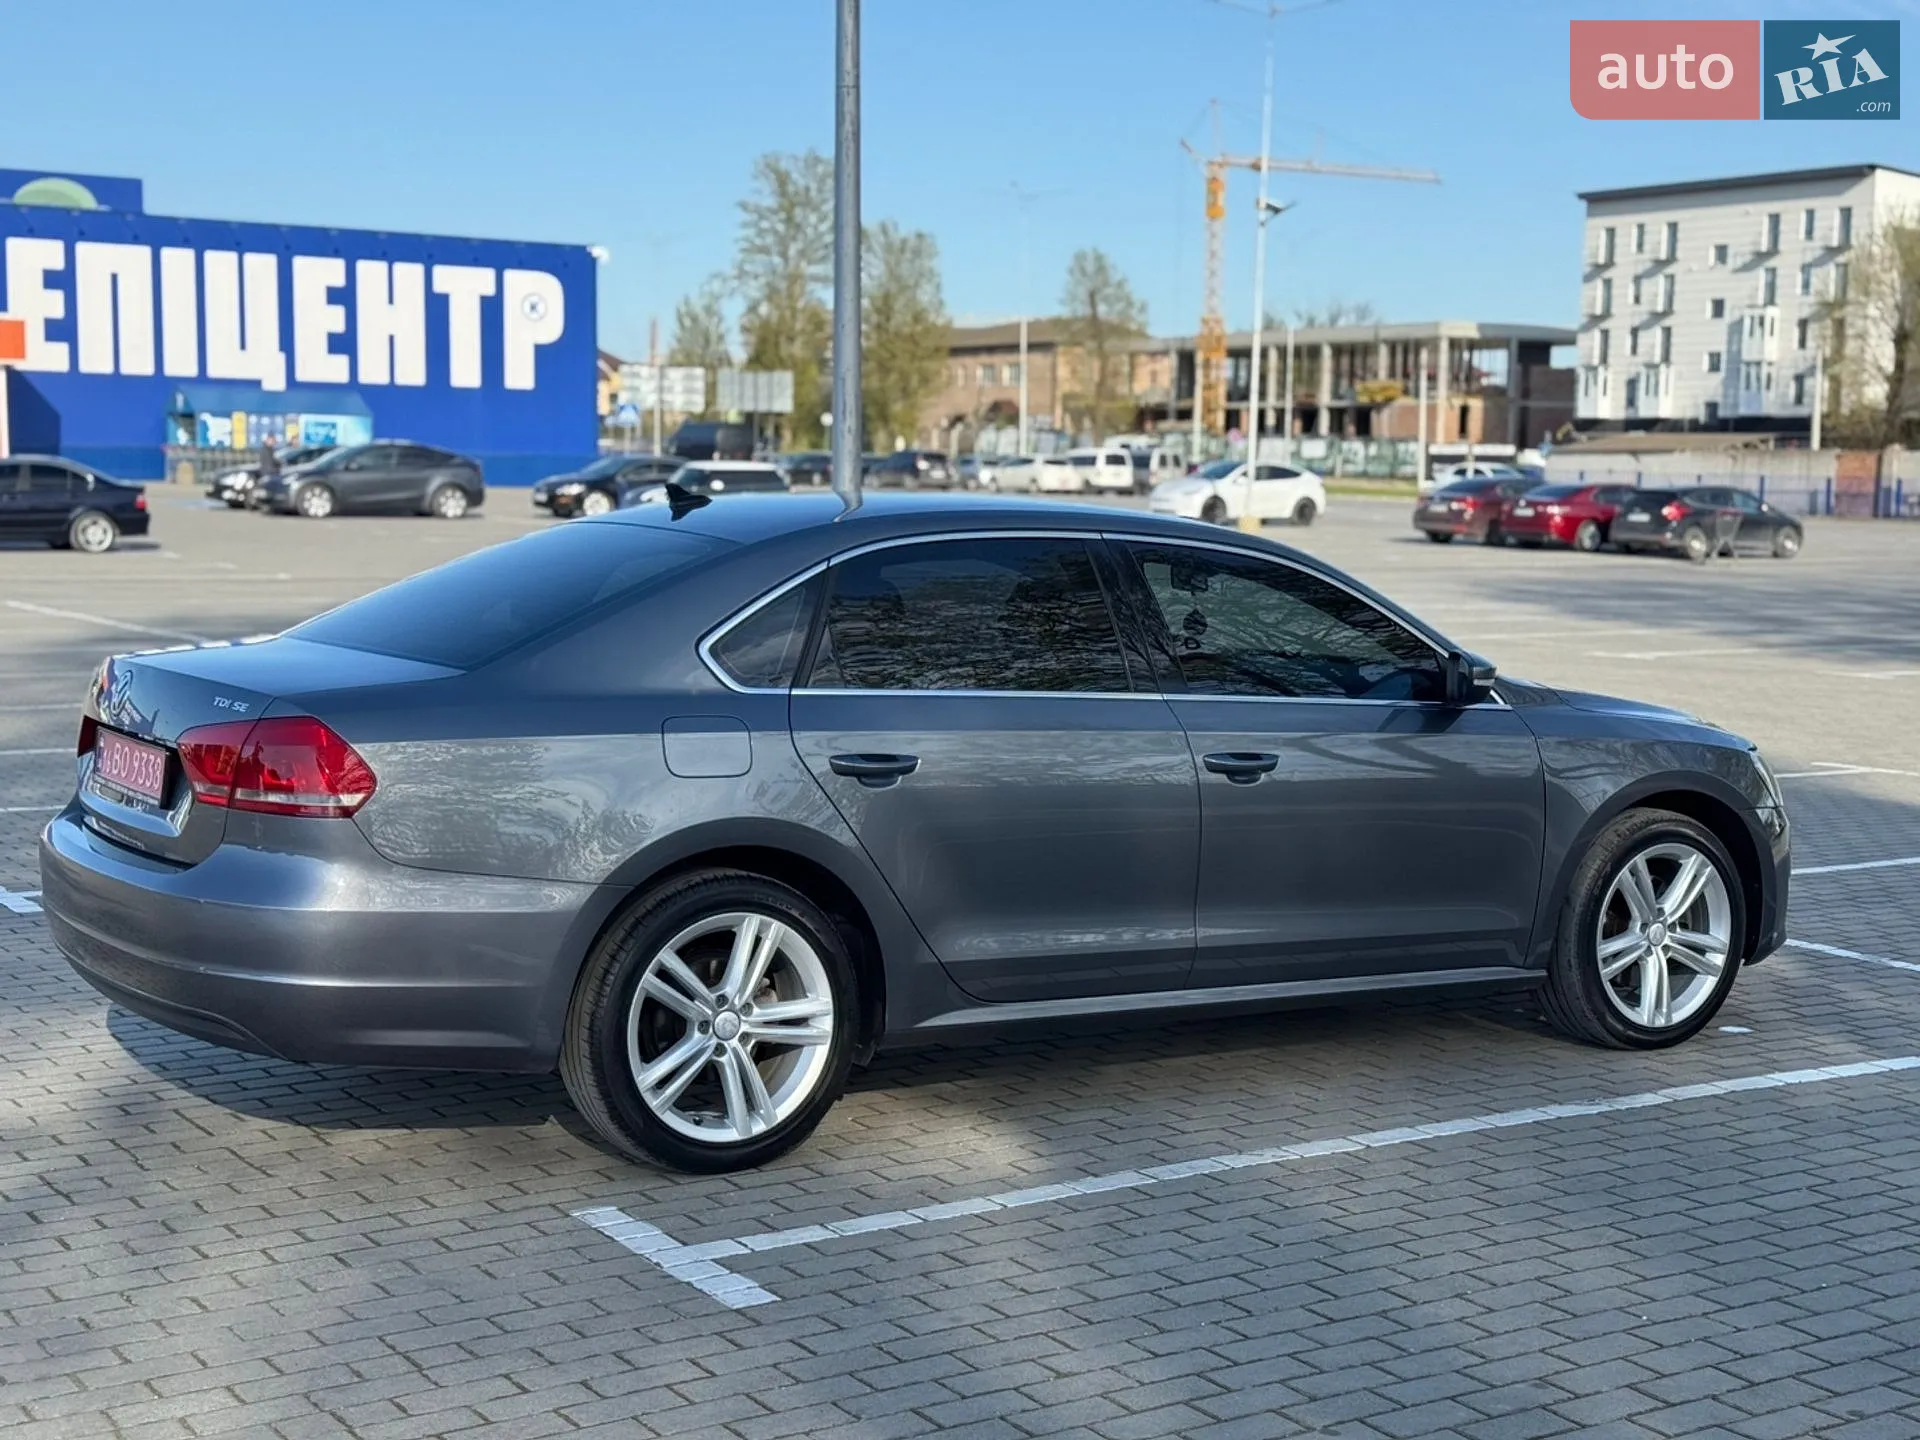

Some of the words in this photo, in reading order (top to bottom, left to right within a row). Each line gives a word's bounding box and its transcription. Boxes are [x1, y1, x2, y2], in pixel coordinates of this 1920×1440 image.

[5, 236, 565, 391] ЕПІЦЕНТР
[213, 696, 231, 708] TDI
[232, 701, 250, 712] SE
